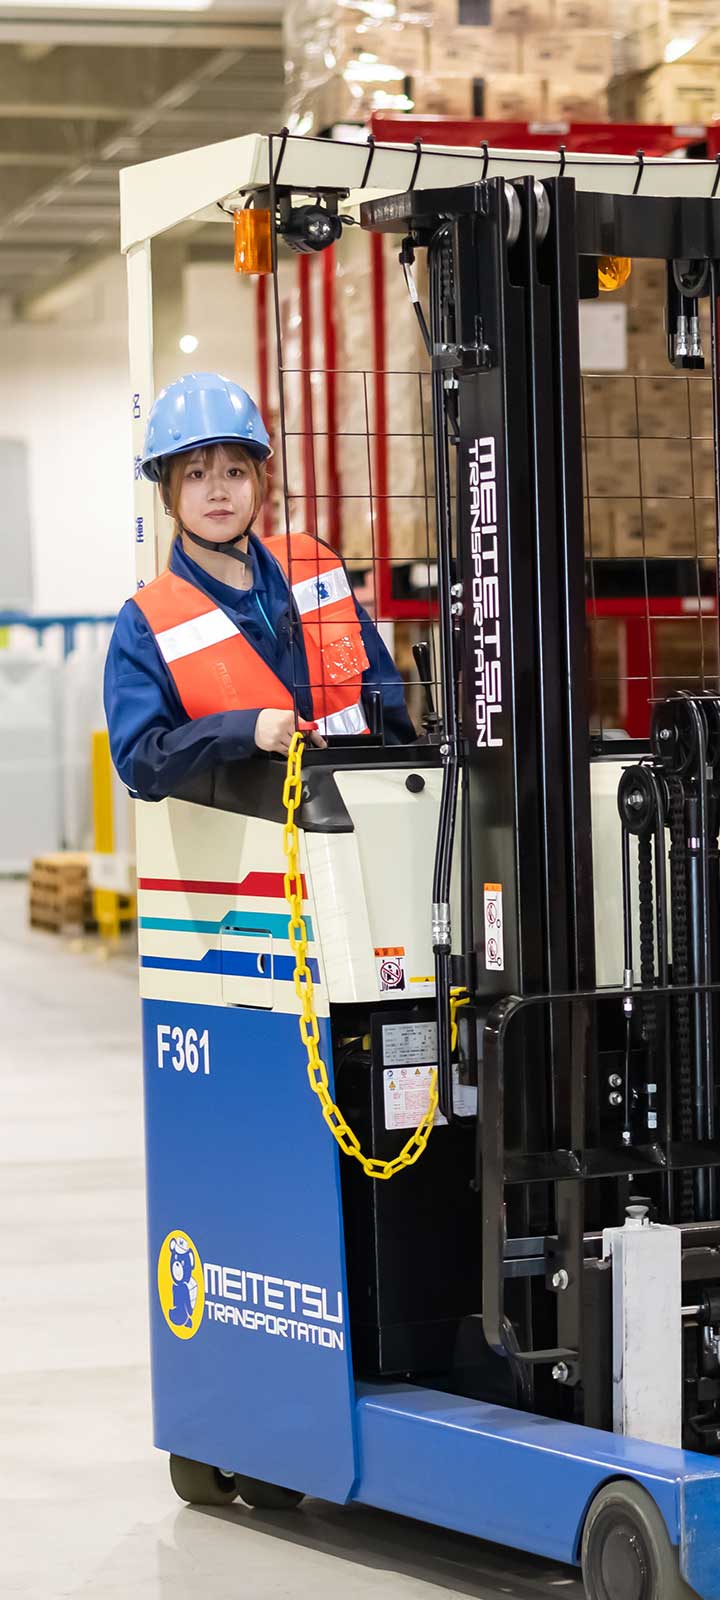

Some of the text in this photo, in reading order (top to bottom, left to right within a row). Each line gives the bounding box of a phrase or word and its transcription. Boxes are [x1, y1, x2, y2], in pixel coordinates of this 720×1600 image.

[468, 438, 487, 748] TRANSPORTATION
[479, 436, 503, 748] MEITETSU
[156, 1024, 210, 1075] F361
[203, 1262, 343, 1324] MEITETSU
[204, 1300, 345, 1351] TRANSPORTATION
